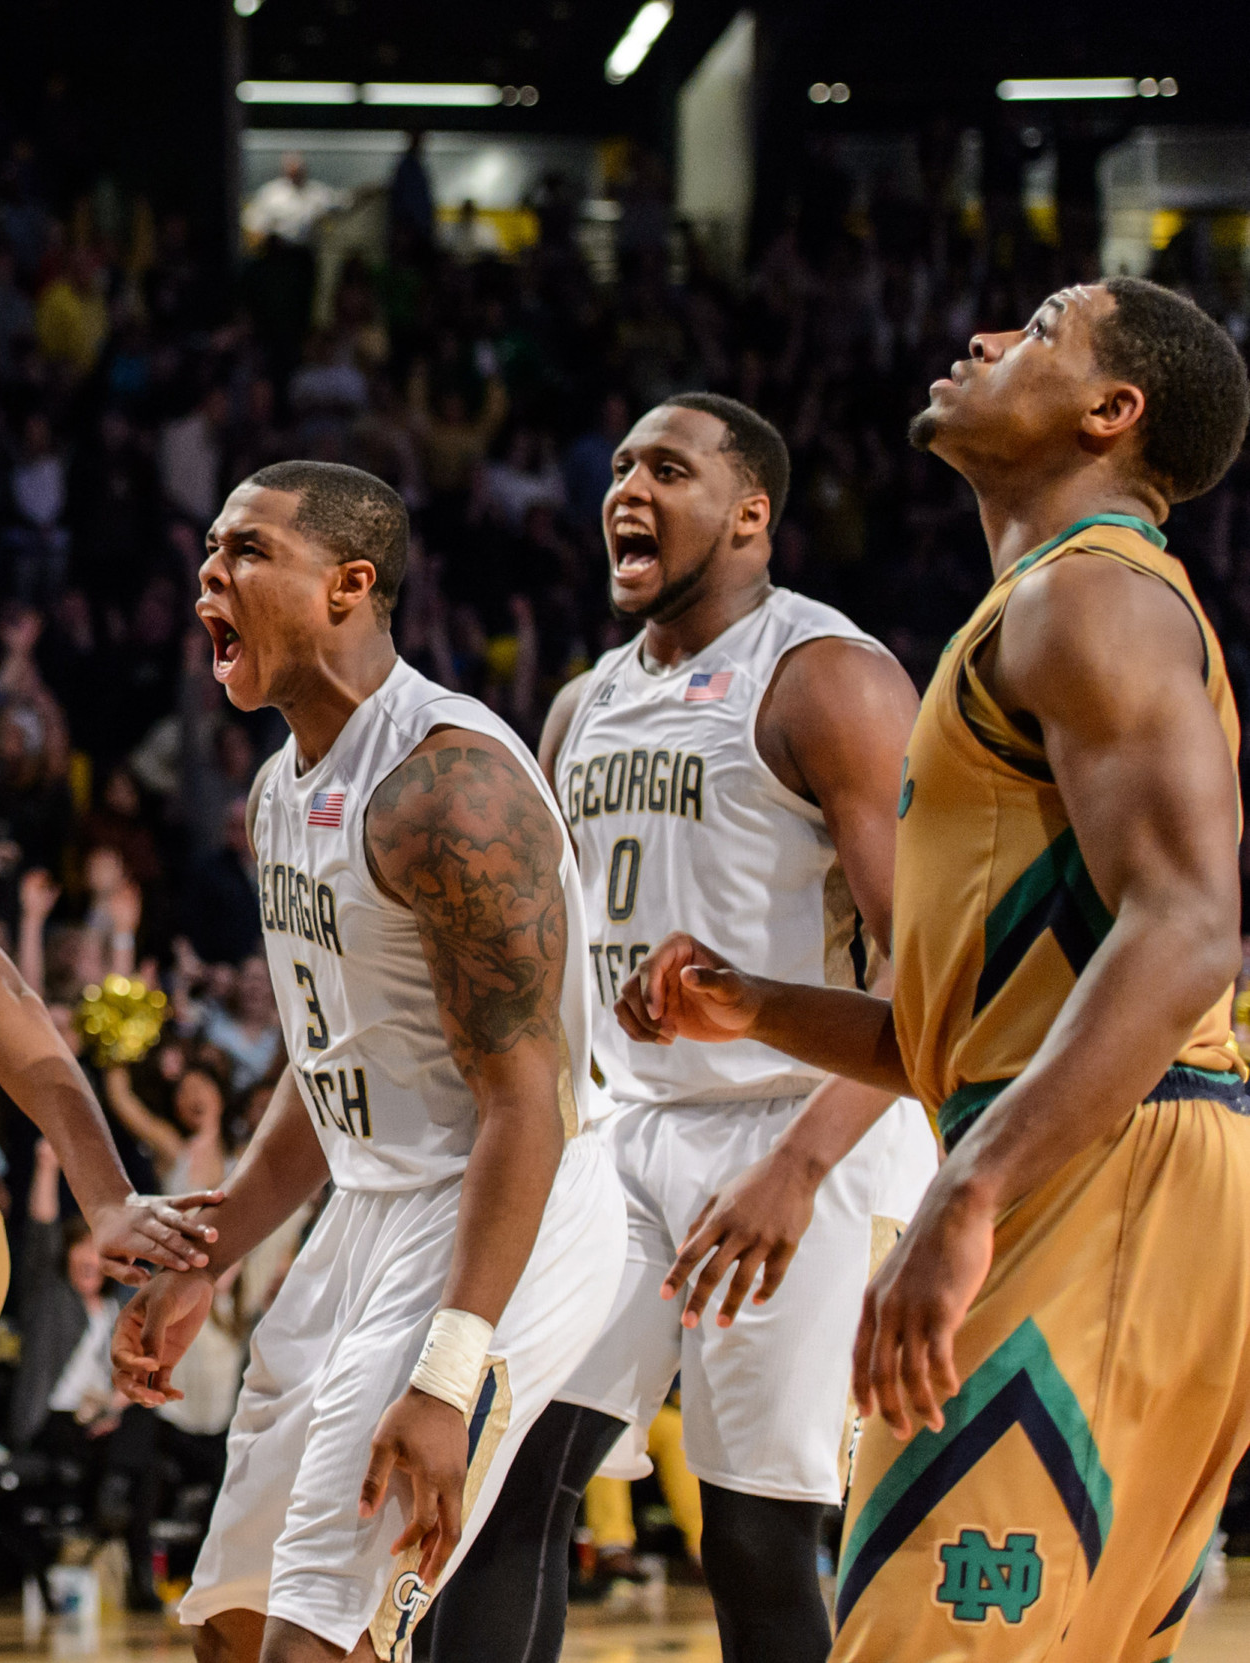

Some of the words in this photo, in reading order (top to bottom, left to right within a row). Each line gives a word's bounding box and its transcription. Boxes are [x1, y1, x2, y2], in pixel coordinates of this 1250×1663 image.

[569, 749, 704, 827] GEORGIA
[259, 861, 344, 958] EORGIA
[606, 835, 643, 925] 0
[293, 959, 330, 1051] 3
[588, 942, 652, 1008] TEC
